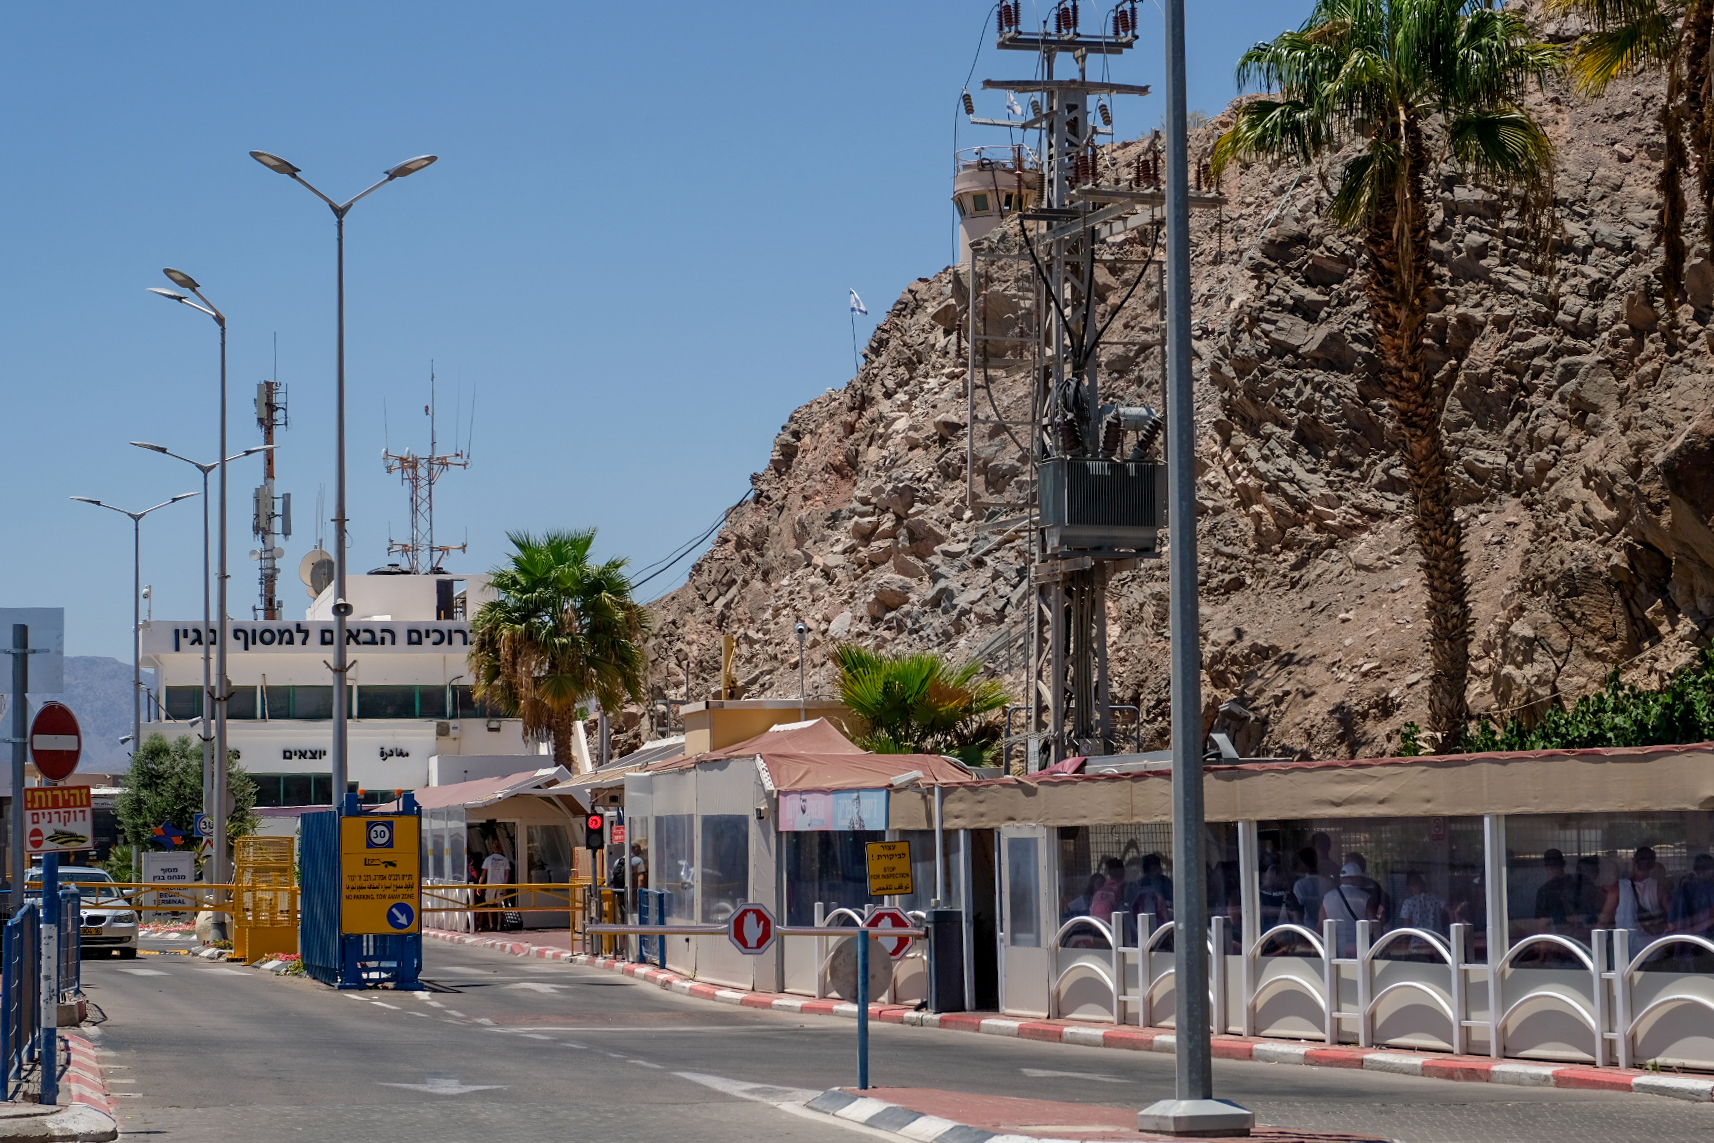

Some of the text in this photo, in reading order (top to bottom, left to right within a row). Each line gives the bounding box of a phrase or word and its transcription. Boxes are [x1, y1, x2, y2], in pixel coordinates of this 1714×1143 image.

[233, 623, 310, 652] למסוף
[320, 628, 396, 646] הבאם
[282, 749, 327, 760] יוצאים
[26, 788, 88, 809] זהירות!
[31, 809, 87, 827] דוקרנים
[372, 830, 386, 839] 30
[160, 867, 178, 875] מסוף
